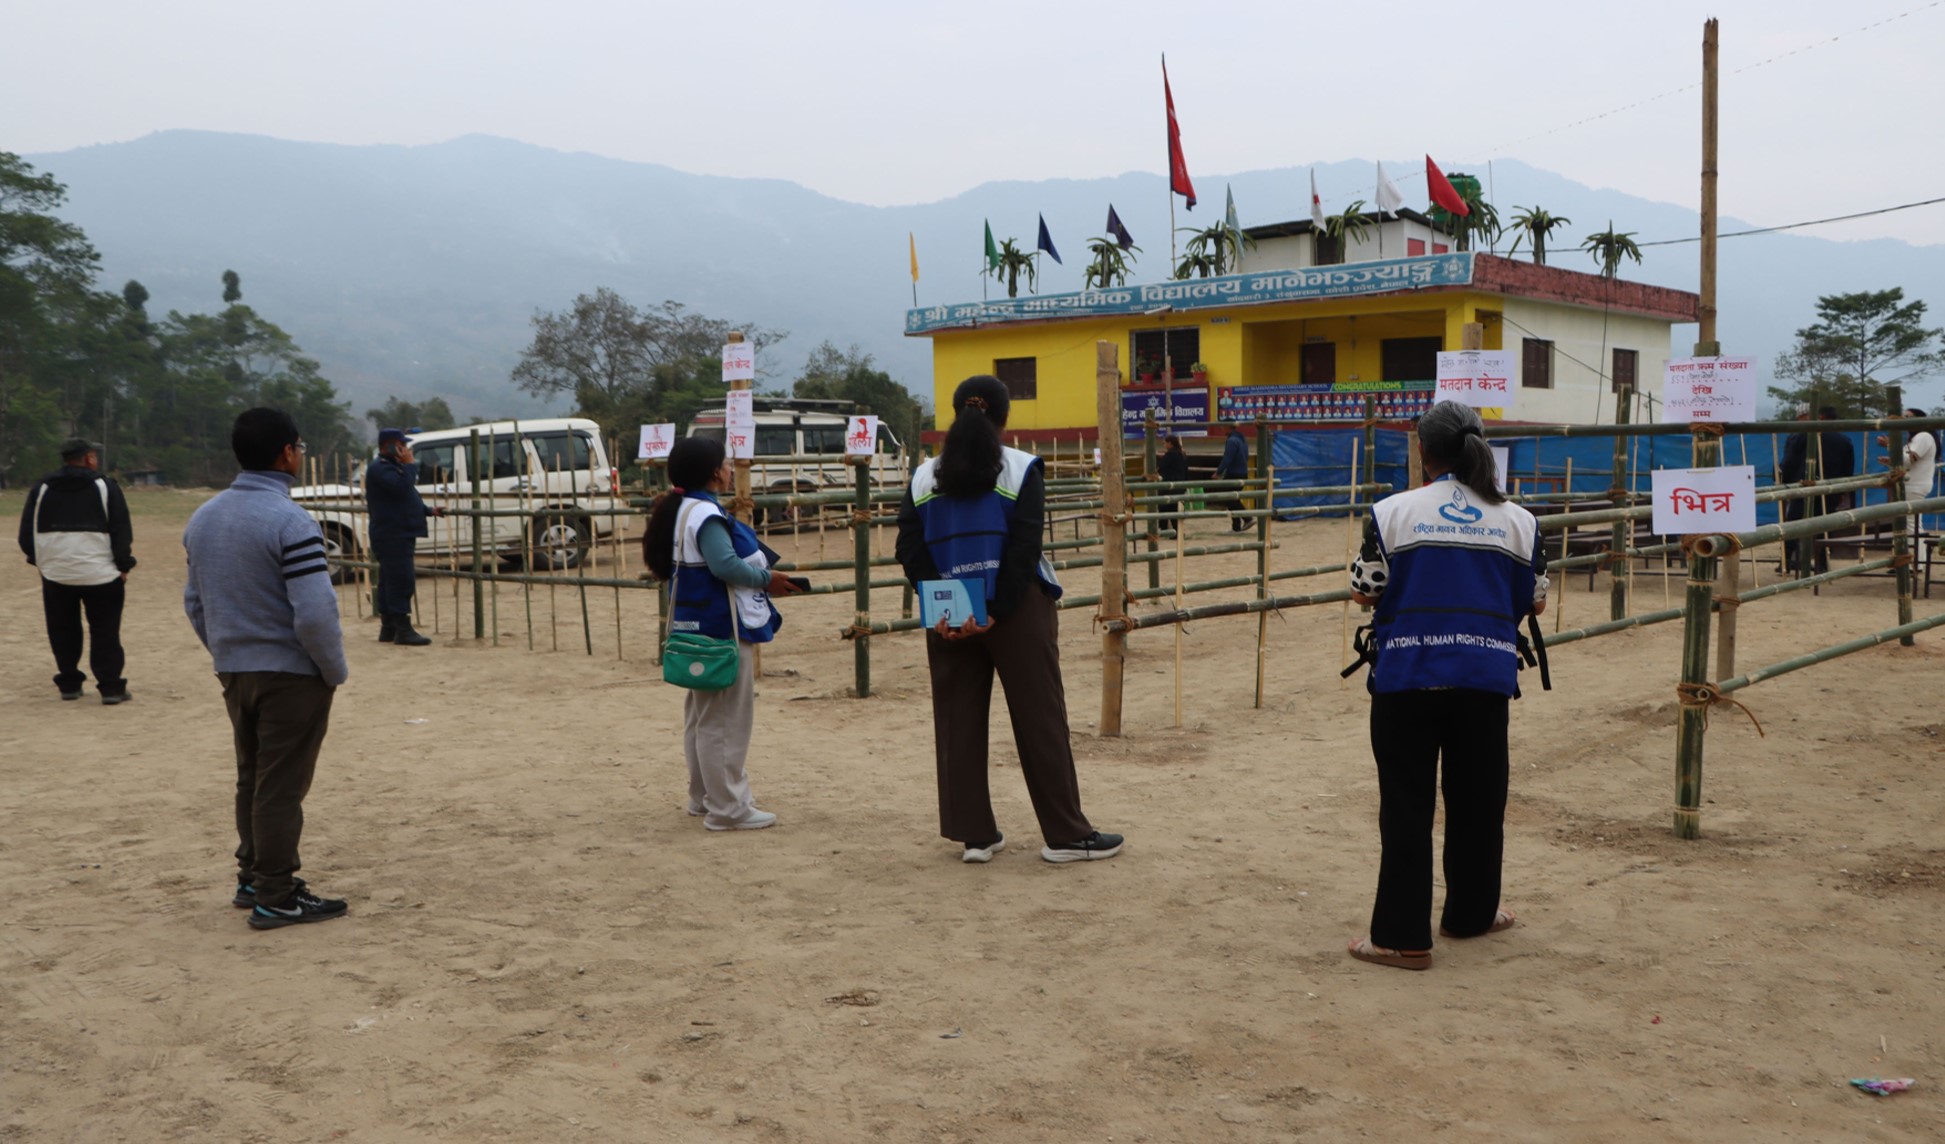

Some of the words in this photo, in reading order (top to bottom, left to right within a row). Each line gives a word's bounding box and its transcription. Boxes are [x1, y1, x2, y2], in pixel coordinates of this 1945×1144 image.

[925, 304, 949, 323] श्री
[1141, 280, 1242, 302] विद्यालय
[1334, 382, 1401, 391] CONGRATULATIONS
[1440, 378, 1473, 392] मतदान
[1477, 372, 1508, 392] केन्द्र
[1692, 384, 1712, 395] देखि
[1670, 487, 1735, 517] भित्र
[1436, 525, 1456, 535] मानव
[1459, 524, 1485, 536] अधिकार
[1423, 634, 1455, 646] HUMAN
[1456, 633, 1485, 648] RIGHTS
